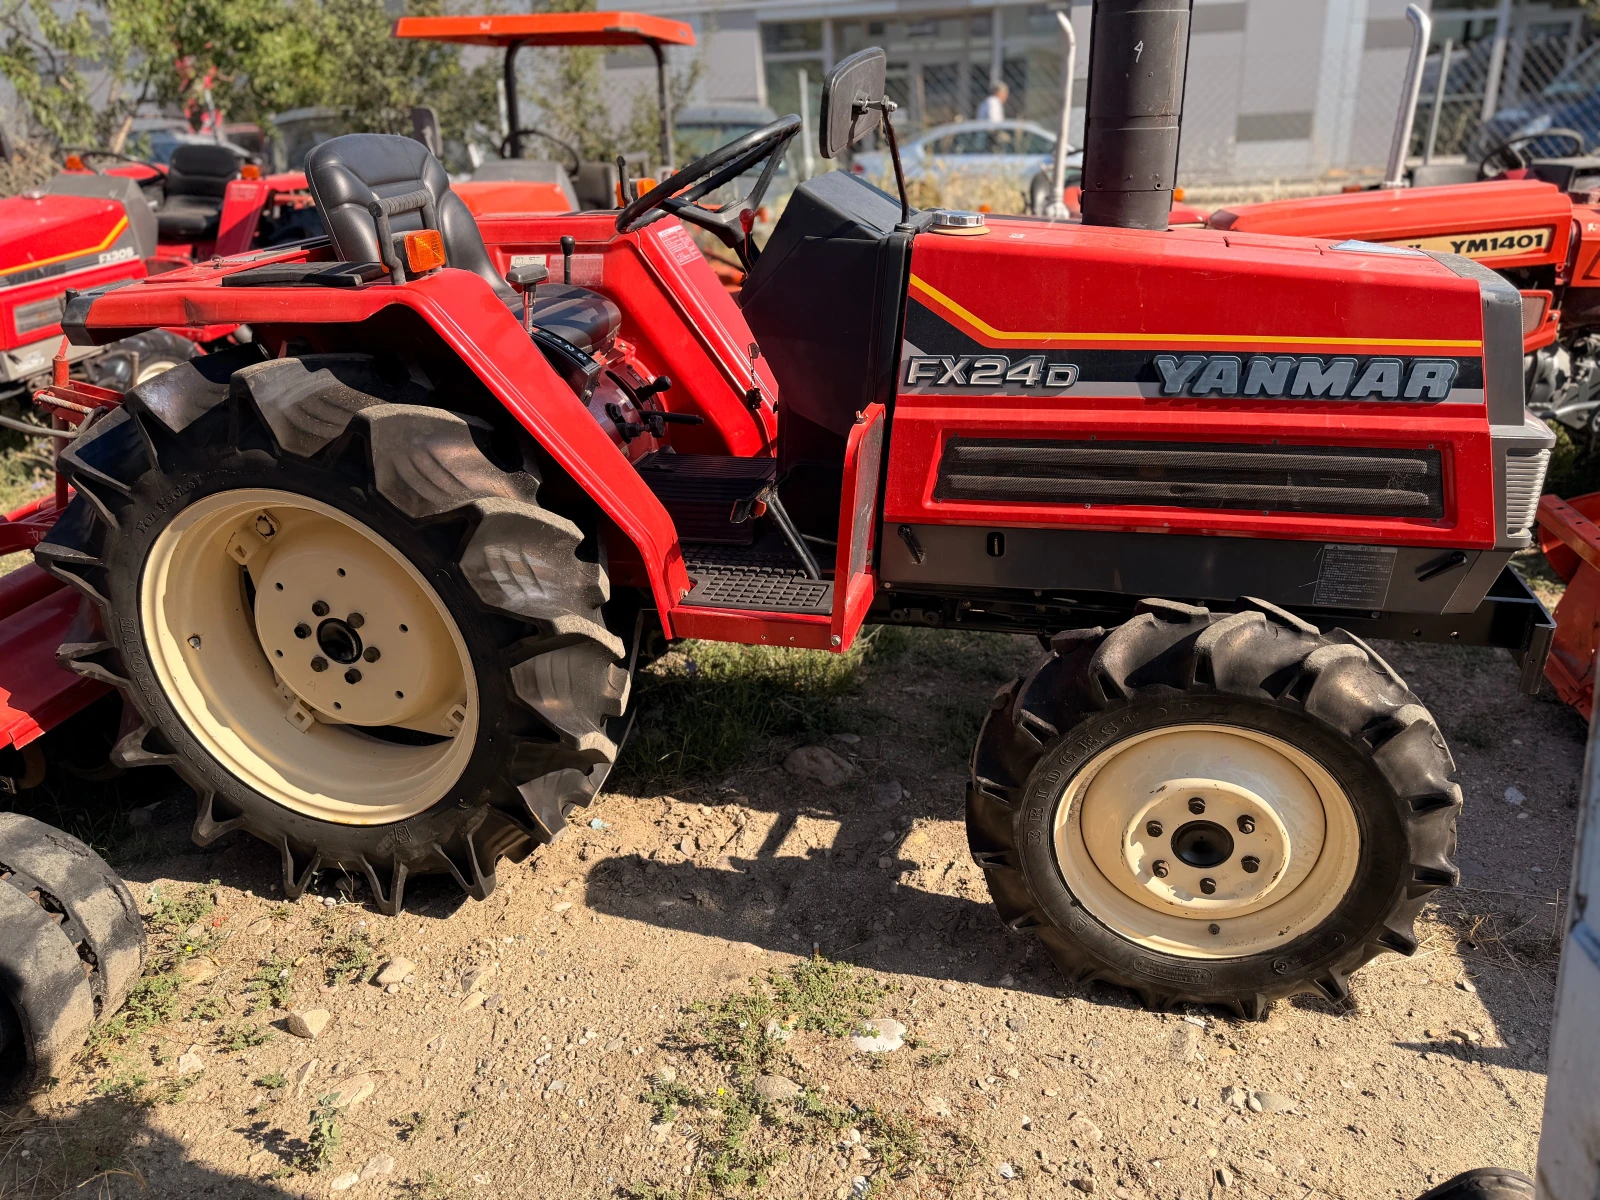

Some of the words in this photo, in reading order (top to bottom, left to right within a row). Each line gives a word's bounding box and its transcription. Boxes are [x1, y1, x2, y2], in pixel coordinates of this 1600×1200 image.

[1133, 40, 1144, 63] 4
[1449, 233, 1545, 254] YM1401
[564, 344, 575, 352] 2
[577, 353, 587, 361] 3
[905, 354, 1080, 388] FX24D
[1154, 355, 1459, 401] YANMAR
[1027, 702, 1232, 845] BRIDGESTONE
